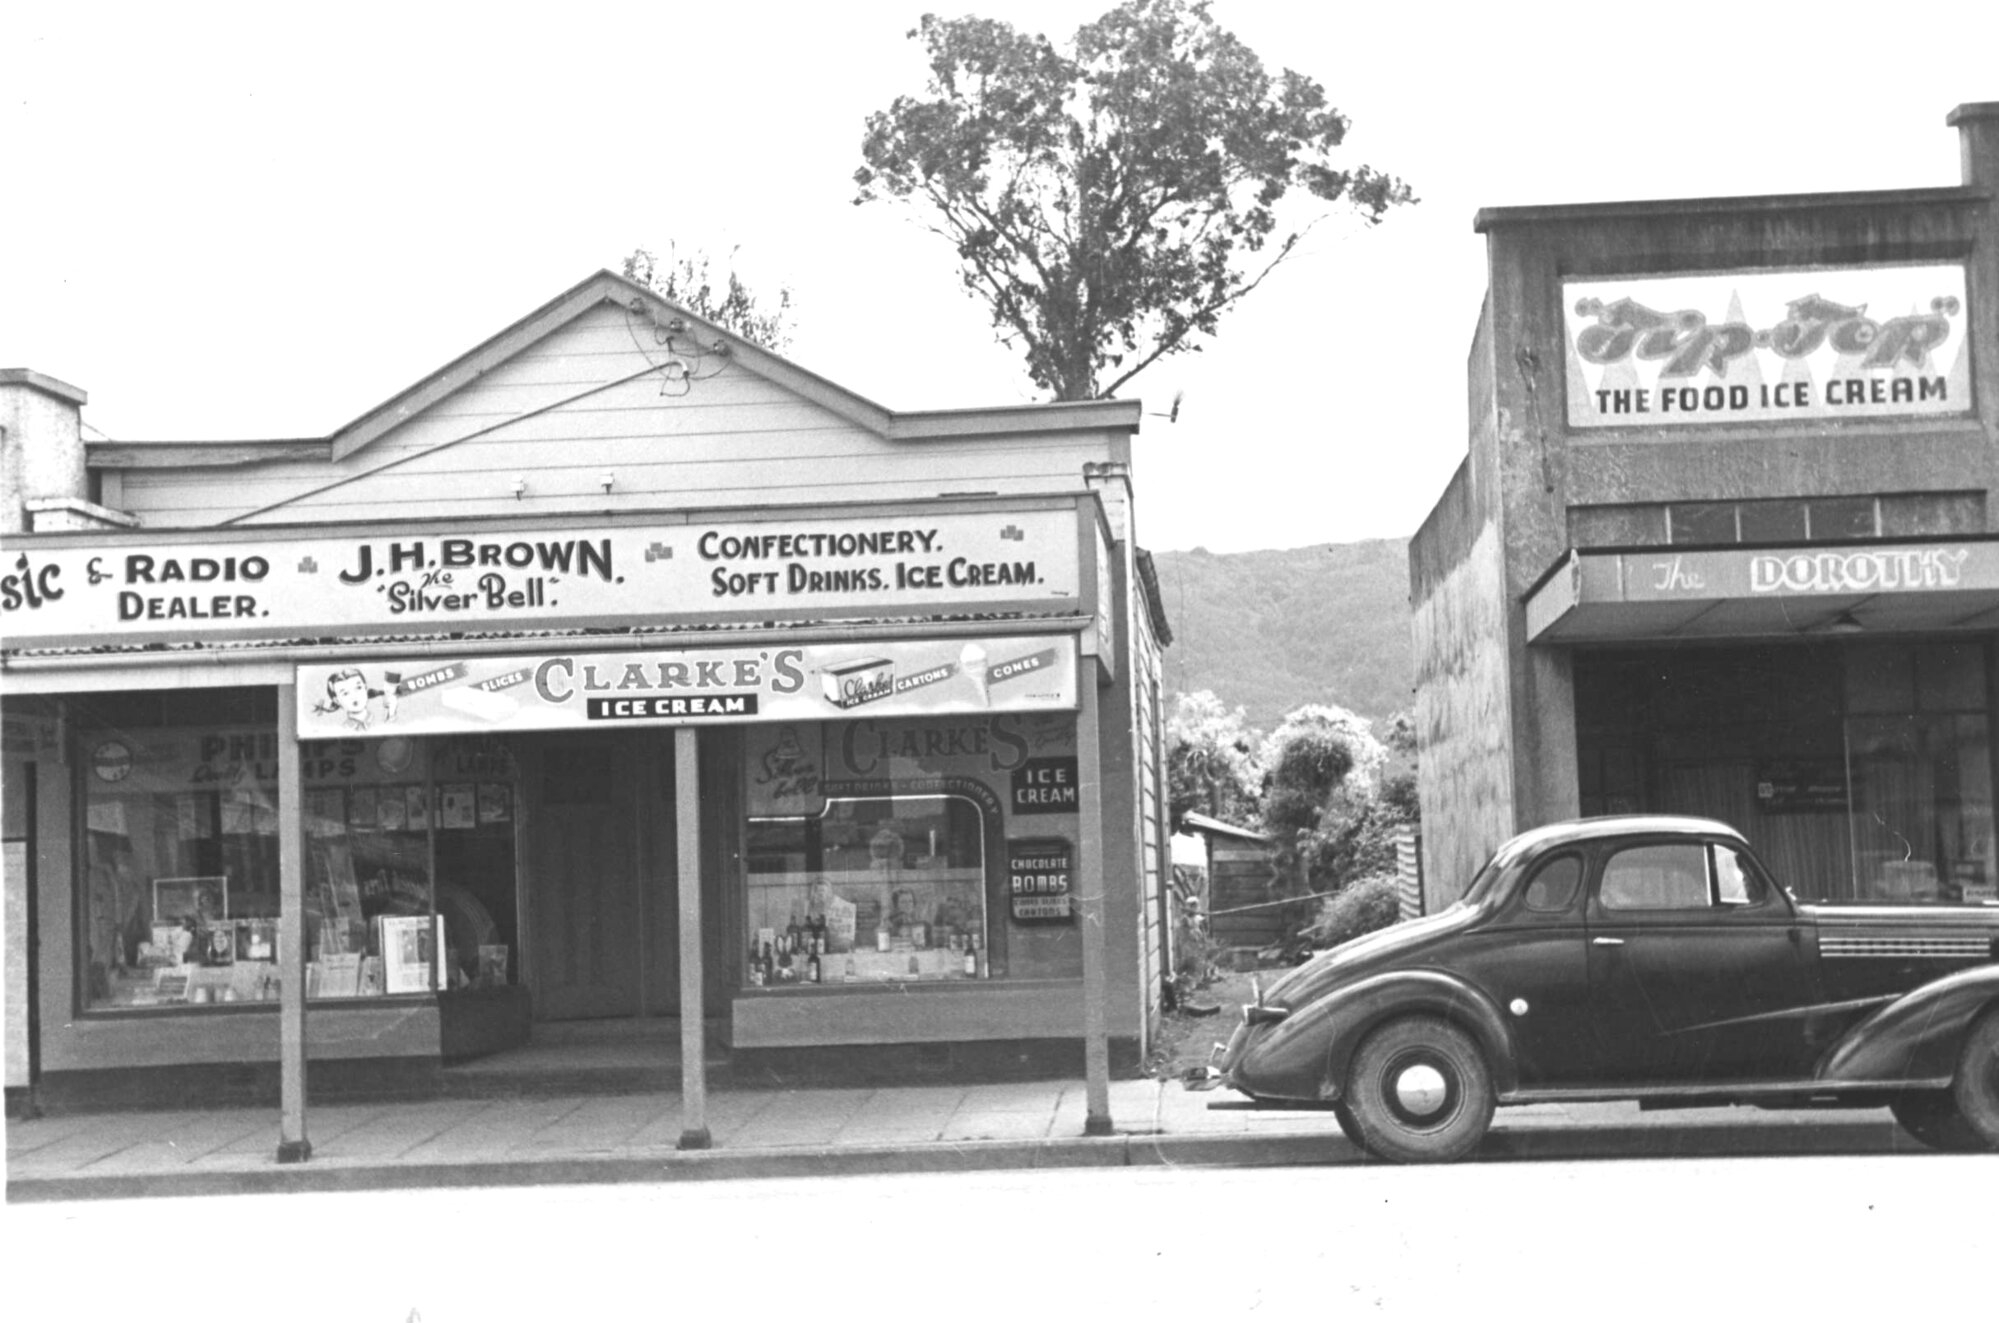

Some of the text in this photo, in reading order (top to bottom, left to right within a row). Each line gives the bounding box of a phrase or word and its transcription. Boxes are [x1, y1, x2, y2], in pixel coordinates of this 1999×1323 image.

[1595, 376, 1947, 414] THE FOOD ICE CREAM
[698, 528, 943, 561] CONFECTIONERY.
[86, 557, 114, 586] &
[125, 554, 270, 584] RADIO
[711, 557, 1045, 597] SOFT DRINKS. ICE CREAM.
[1653, 549, 1968, 592] The DOROTHY
[118, 590, 271, 621] DEALER.
[535, 650, 804, 703] CLARKE'S
[994, 656, 1040, 678] CONES
[407, 668, 455, 690] BOMBS
[481, 672, 524, 692] SLICES
[897, 669, 949, 690] CARTONS
[601, 697, 745, 717] ICE CREAM
[1027, 768, 1066, 784] ICE
[1016, 787, 1075, 804] CREAM
[1011, 858, 1068, 870] CHOCOLATE
[1012, 875, 1068, 893] BOMBS
